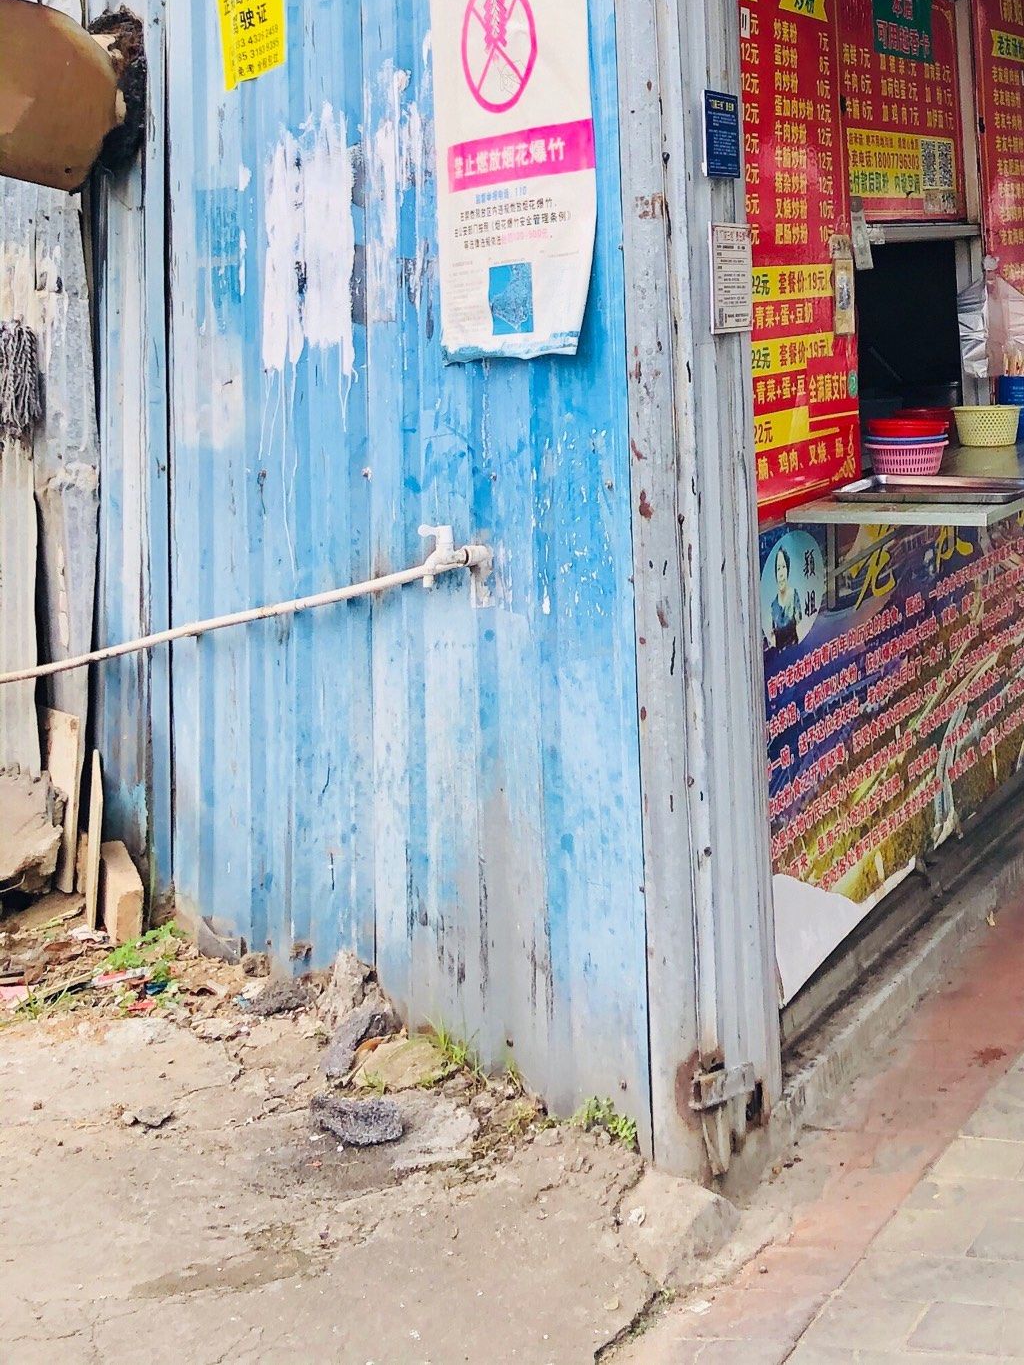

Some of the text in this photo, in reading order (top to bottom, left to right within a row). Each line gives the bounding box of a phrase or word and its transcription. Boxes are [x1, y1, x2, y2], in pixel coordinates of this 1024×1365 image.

[773, 18, 798, 44] 炒素粉
[773, 44, 798, 68] 蛋炒粉
[774, 69, 799, 94] 肉炒粉
[844, 69, 858, 94] 牛肉
[774, 94, 814, 121] 蛋加肉炒粉
[816, 103, 832, 123] 12元
[774, 120, 807, 145] 牛肉炒粉
[818, 127, 833, 147] 12元
[454, 137, 566, 180] 禁止燃放烟花爆竹
[774, 145, 807, 170] 牛腩炒粉
[818, 151, 833, 171] 12元
[850, 149, 920, 170] 卖电话:18007796303
[775, 171, 808, 195] 猪杂炒粉
[775, 197, 808, 220] 叉烧炒粉
[774, 222, 808, 245] 肥肠炒粉
